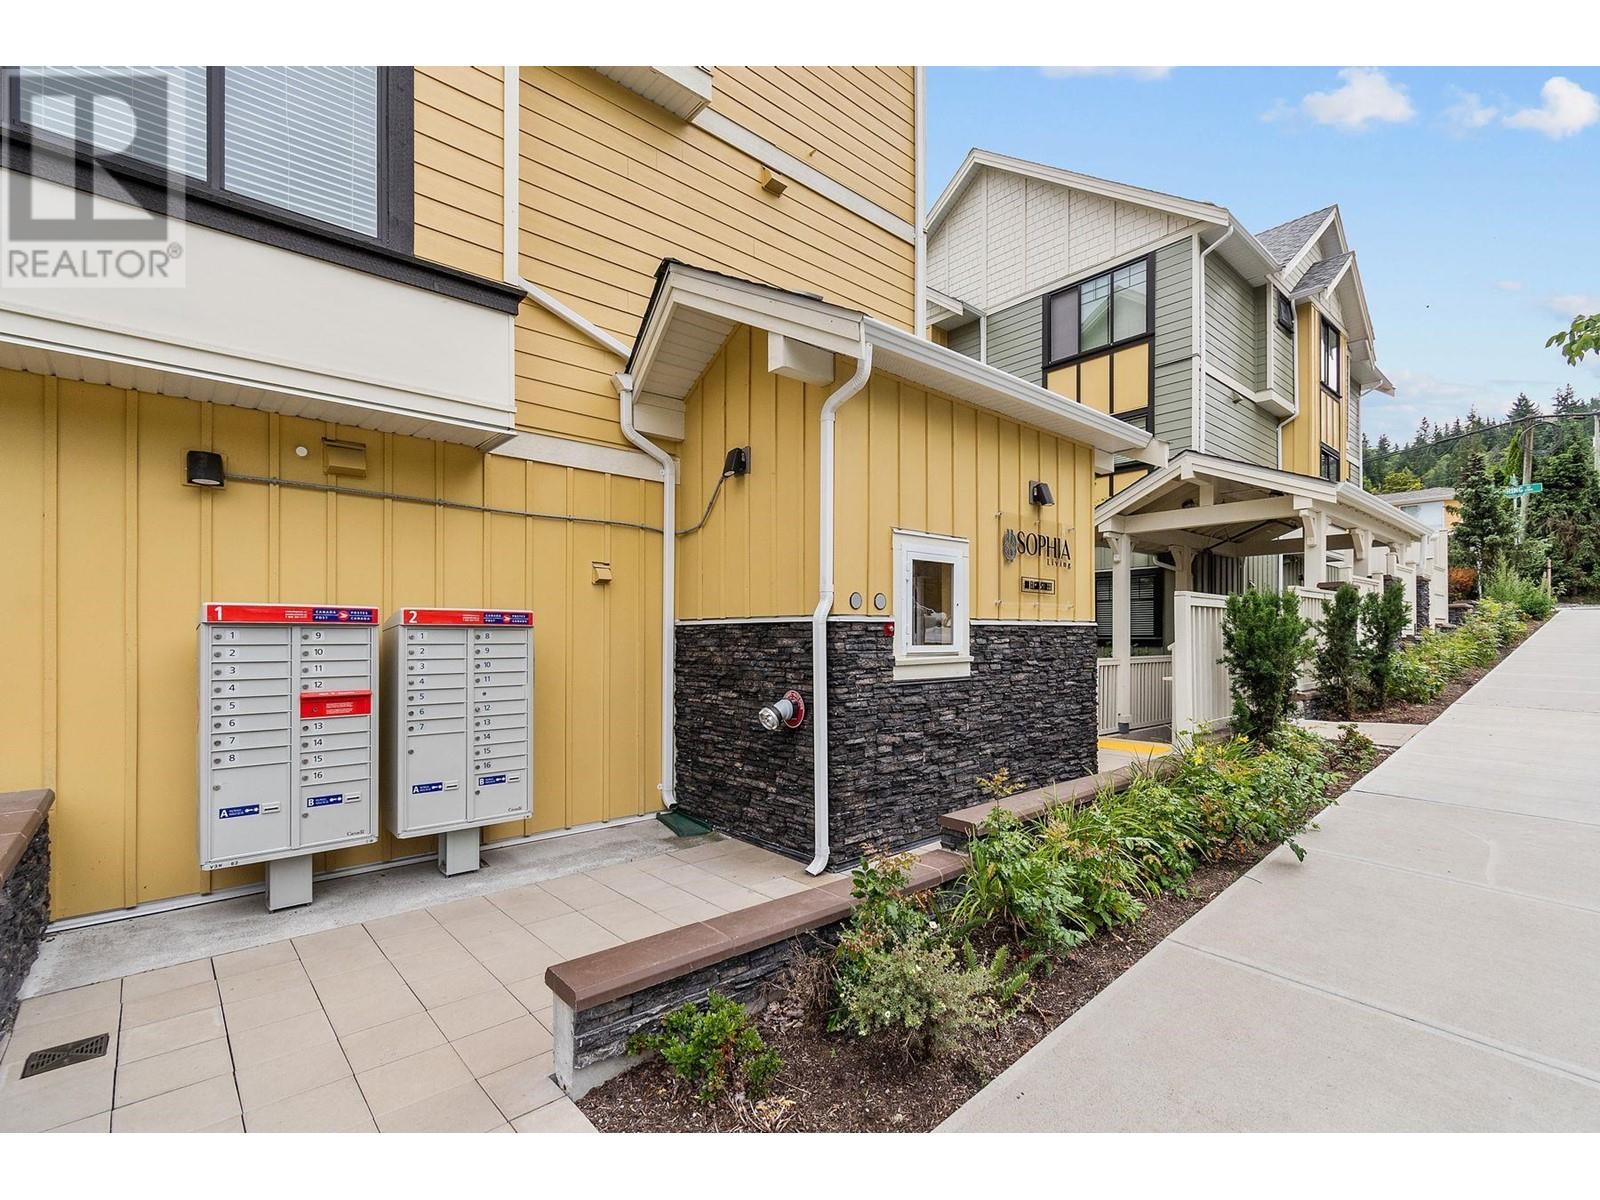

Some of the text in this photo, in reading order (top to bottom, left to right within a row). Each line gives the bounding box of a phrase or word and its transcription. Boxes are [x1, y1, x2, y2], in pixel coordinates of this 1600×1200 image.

[1017, 530, 1071, 560] SOPHIA
[214, 606, 223, 621] 1
[408, 610, 418, 624] 2
[315, 631, 322, 639] 9
[421, 632, 424, 640] 1
[313, 648, 324, 656] 10
[420, 647, 425, 655] 2
[313, 664, 323, 672] 11
[420, 662, 425, 670] 3
[483, 660, 491, 668] 10
[483, 675, 490, 683] 11
[229, 684, 237, 692] 4
[313, 681, 323, 689] 12
[419, 693, 425, 701] 5
[229, 702, 236, 710] 5
[483, 704, 491, 712] 12
[419, 708, 425, 716] 6
[229, 719, 236, 727] 6
[313, 722, 323, 730] 13
[419, 723, 425, 731] 7
[229, 736, 236, 744] 7
[483, 733, 491, 741] 14
[313, 738, 323, 747] 14
[483, 747, 491, 755] 15
[229, 754, 236, 762] 8
[313, 755, 323, 763] 15
[483, 762, 491, 770] 16
[313, 771, 323, 780] 16
[412, 786, 420, 794] A
[308, 798, 315, 807] B
[219, 809, 229, 818] A
